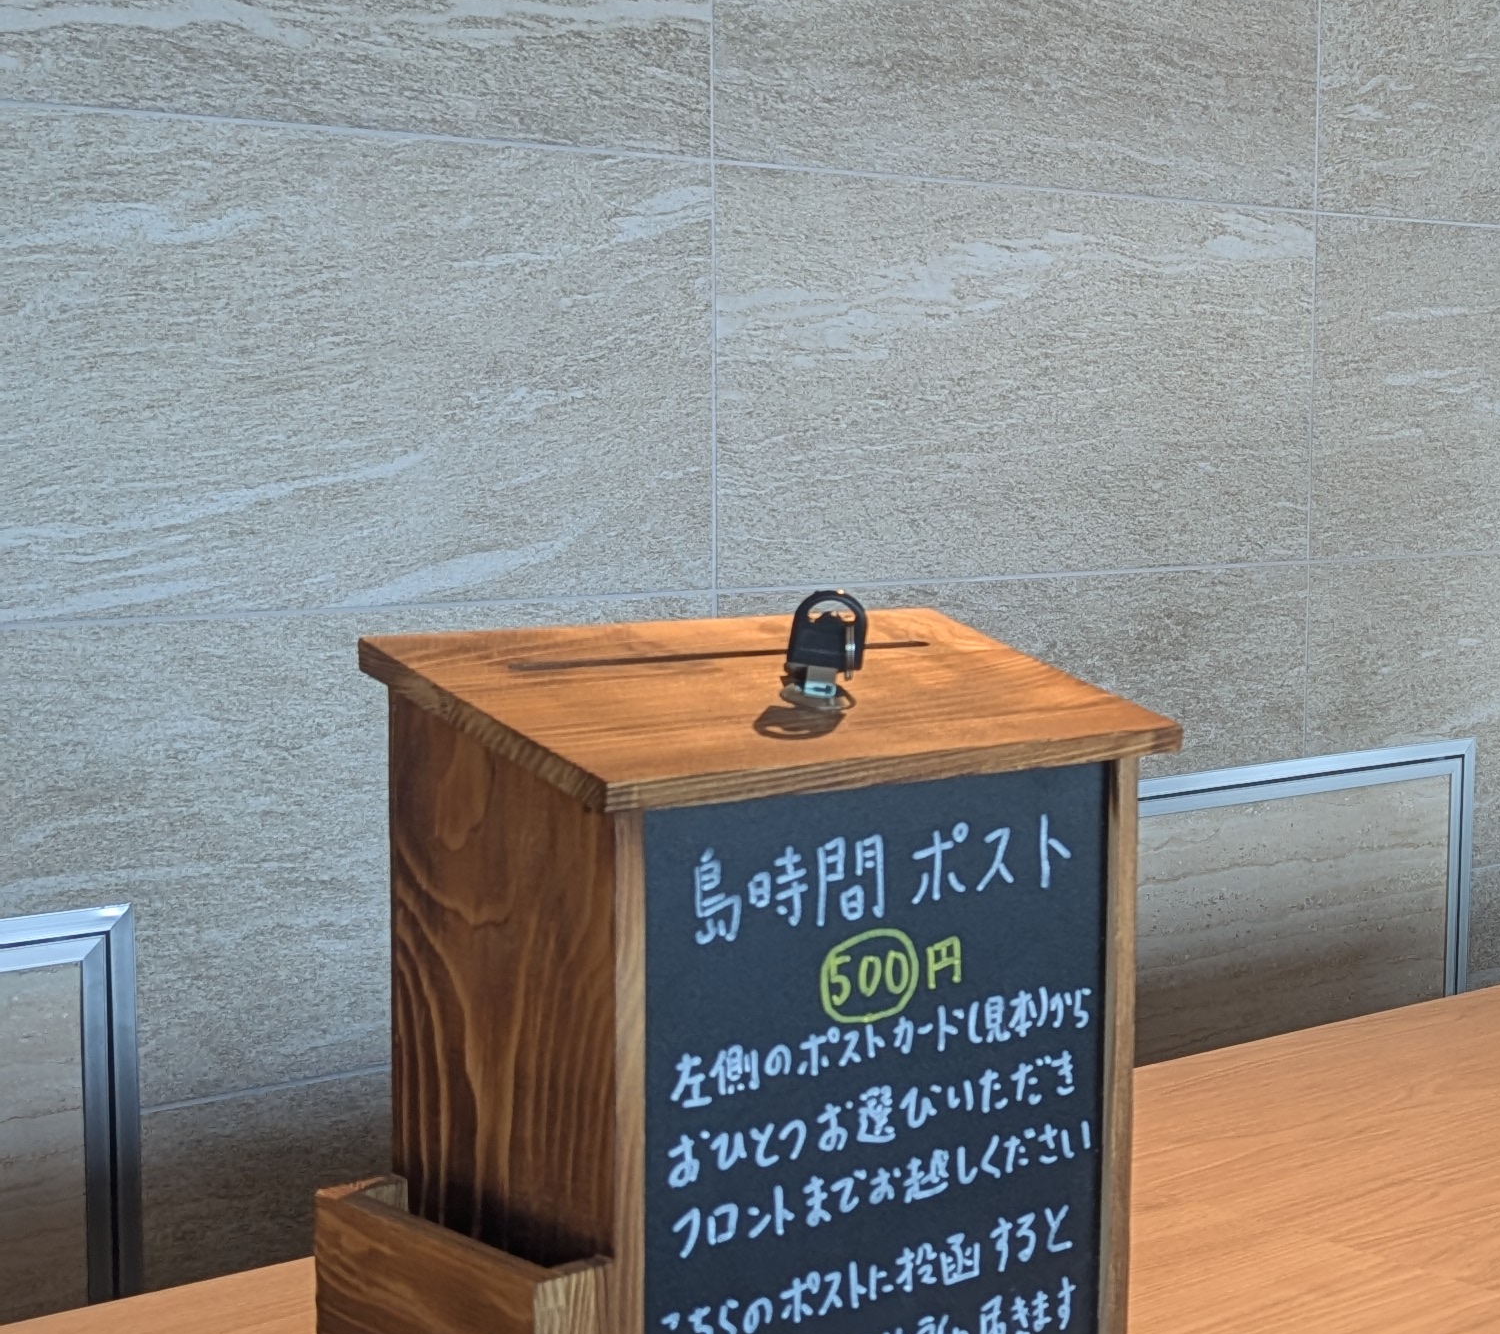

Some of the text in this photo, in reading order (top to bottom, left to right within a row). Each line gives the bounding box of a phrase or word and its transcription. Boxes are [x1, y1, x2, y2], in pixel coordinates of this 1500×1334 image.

[668, 1051, 1075, 1188] おひとつお選びいただき
[672, 1121, 1092, 1259] フロントまでお越しください
